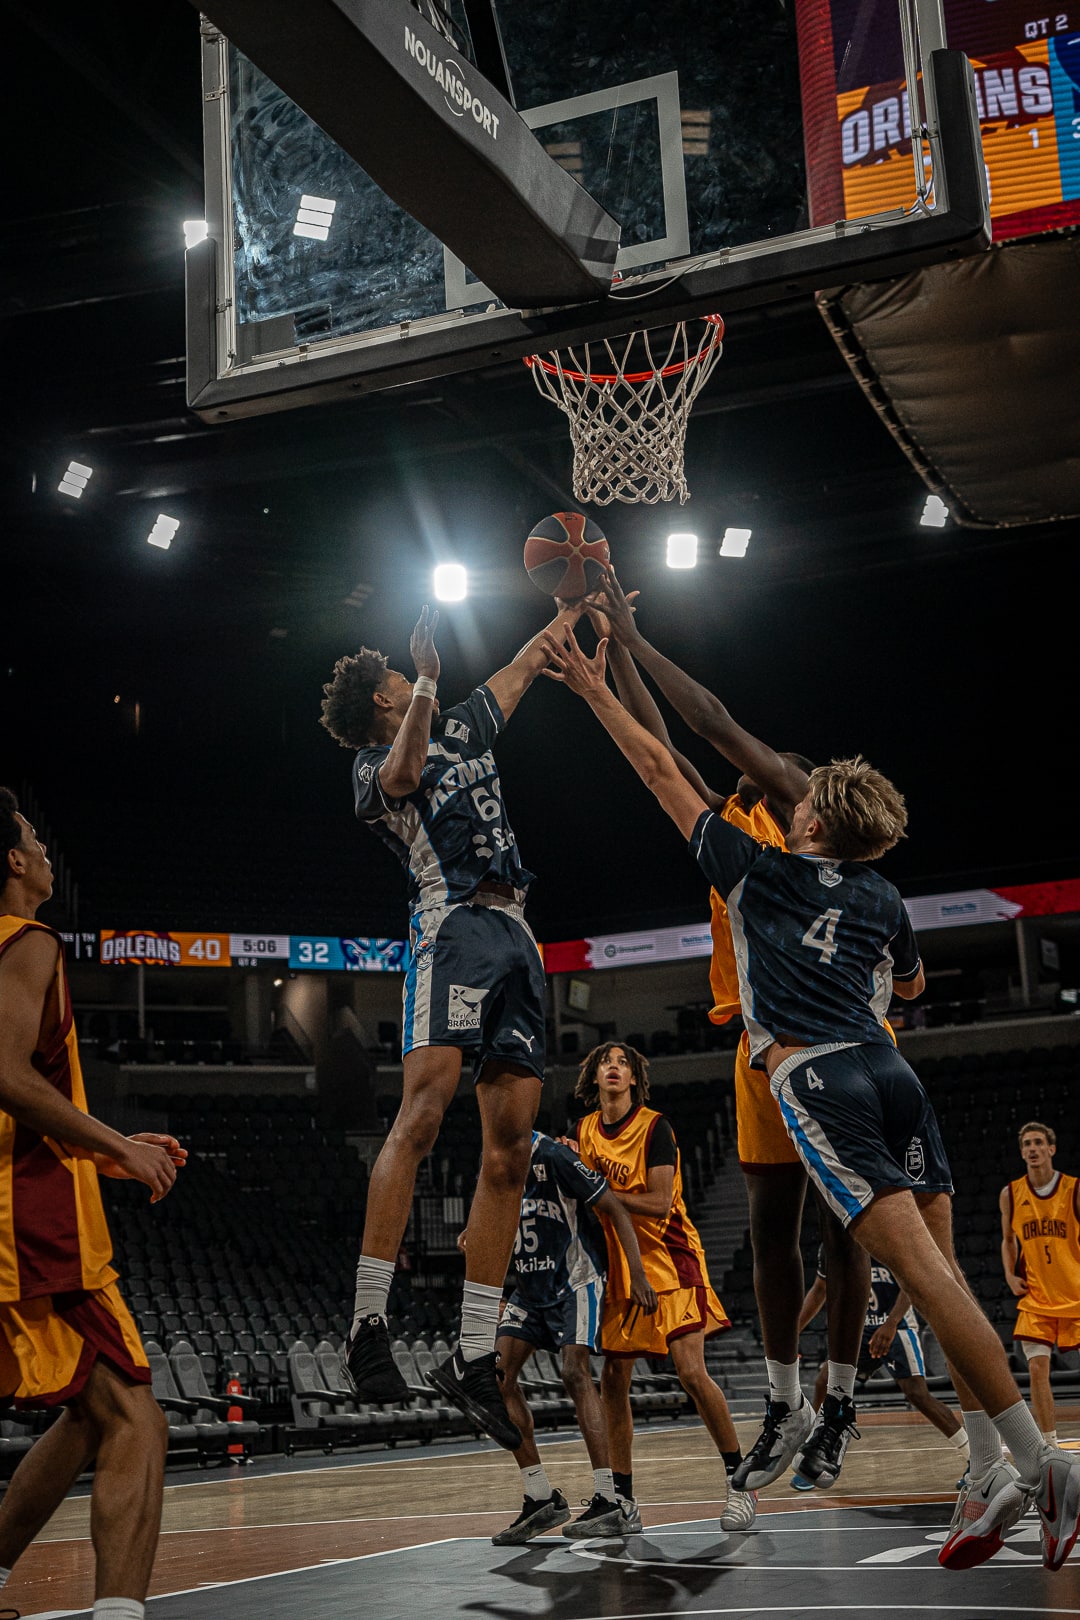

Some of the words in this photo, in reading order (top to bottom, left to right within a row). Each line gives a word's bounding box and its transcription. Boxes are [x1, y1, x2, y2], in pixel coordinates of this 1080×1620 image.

[1024, 18, 1050, 38] QT
[1055, 14, 1069, 31] 2
[404, 26, 500, 140] NOUANSPORT
[1028, 127, 1040, 148] 1
[242, 940, 277, 954] 5:06
[801, 908, 843, 965] 4
[188, 939, 220, 960] 40
[299, 942, 329, 963] 32
[805, 1066, 825, 1092] 4
[520, 1198, 565, 1224] PER
[1044, 1245, 1052, 1265] 5
